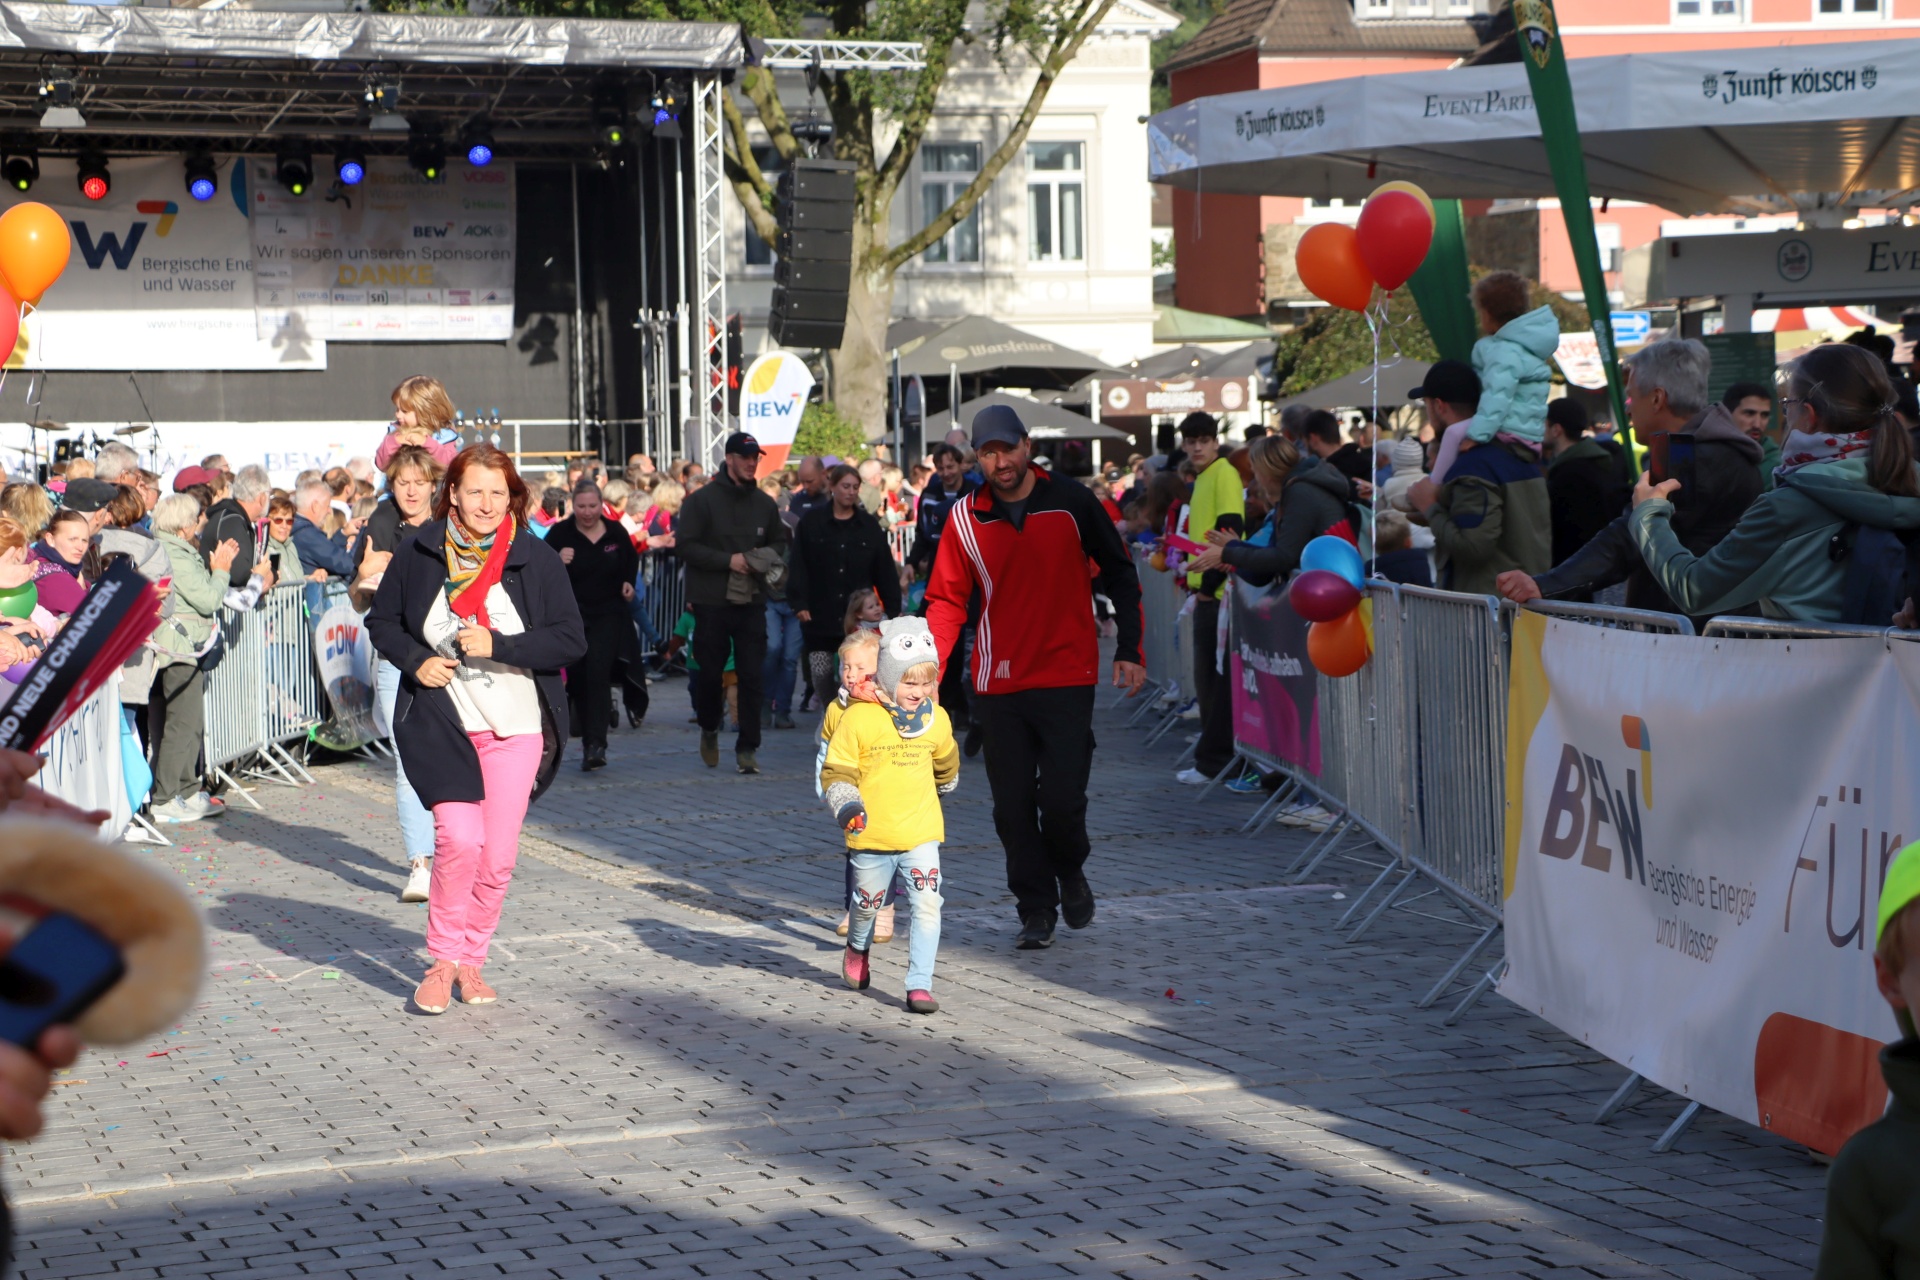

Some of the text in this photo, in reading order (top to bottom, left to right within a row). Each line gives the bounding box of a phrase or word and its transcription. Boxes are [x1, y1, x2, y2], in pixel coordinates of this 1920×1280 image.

[1722, 67, 1856, 104] Zunft KÖLSCH
[1279, 107, 1315, 132] KÖLSCH
[463, 171, 506, 184] VOSS
[413, 226, 448, 238] BEW
[463, 225, 493, 237] AOK
[257, 245, 511, 262] Wir sagen unseren Sponsoren
[142, 257, 221, 274] Bergische
[338, 264, 434, 286] DANKE
[143, 278, 236, 291] und Wasser
[968, 341, 1055, 358] Warsteiner
[747, 400, 793, 418] BEW
[264, 452, 332, 472] BEW
[13, 669, 57, 719] NEUE
[50, 579, 123, 671] CHANCEN.
[1539, 743, 1647, 887] BEW
[1648, 861, 1757, 926] Bergische Energie
[1656, 916, 1719, 965] und Wasser
